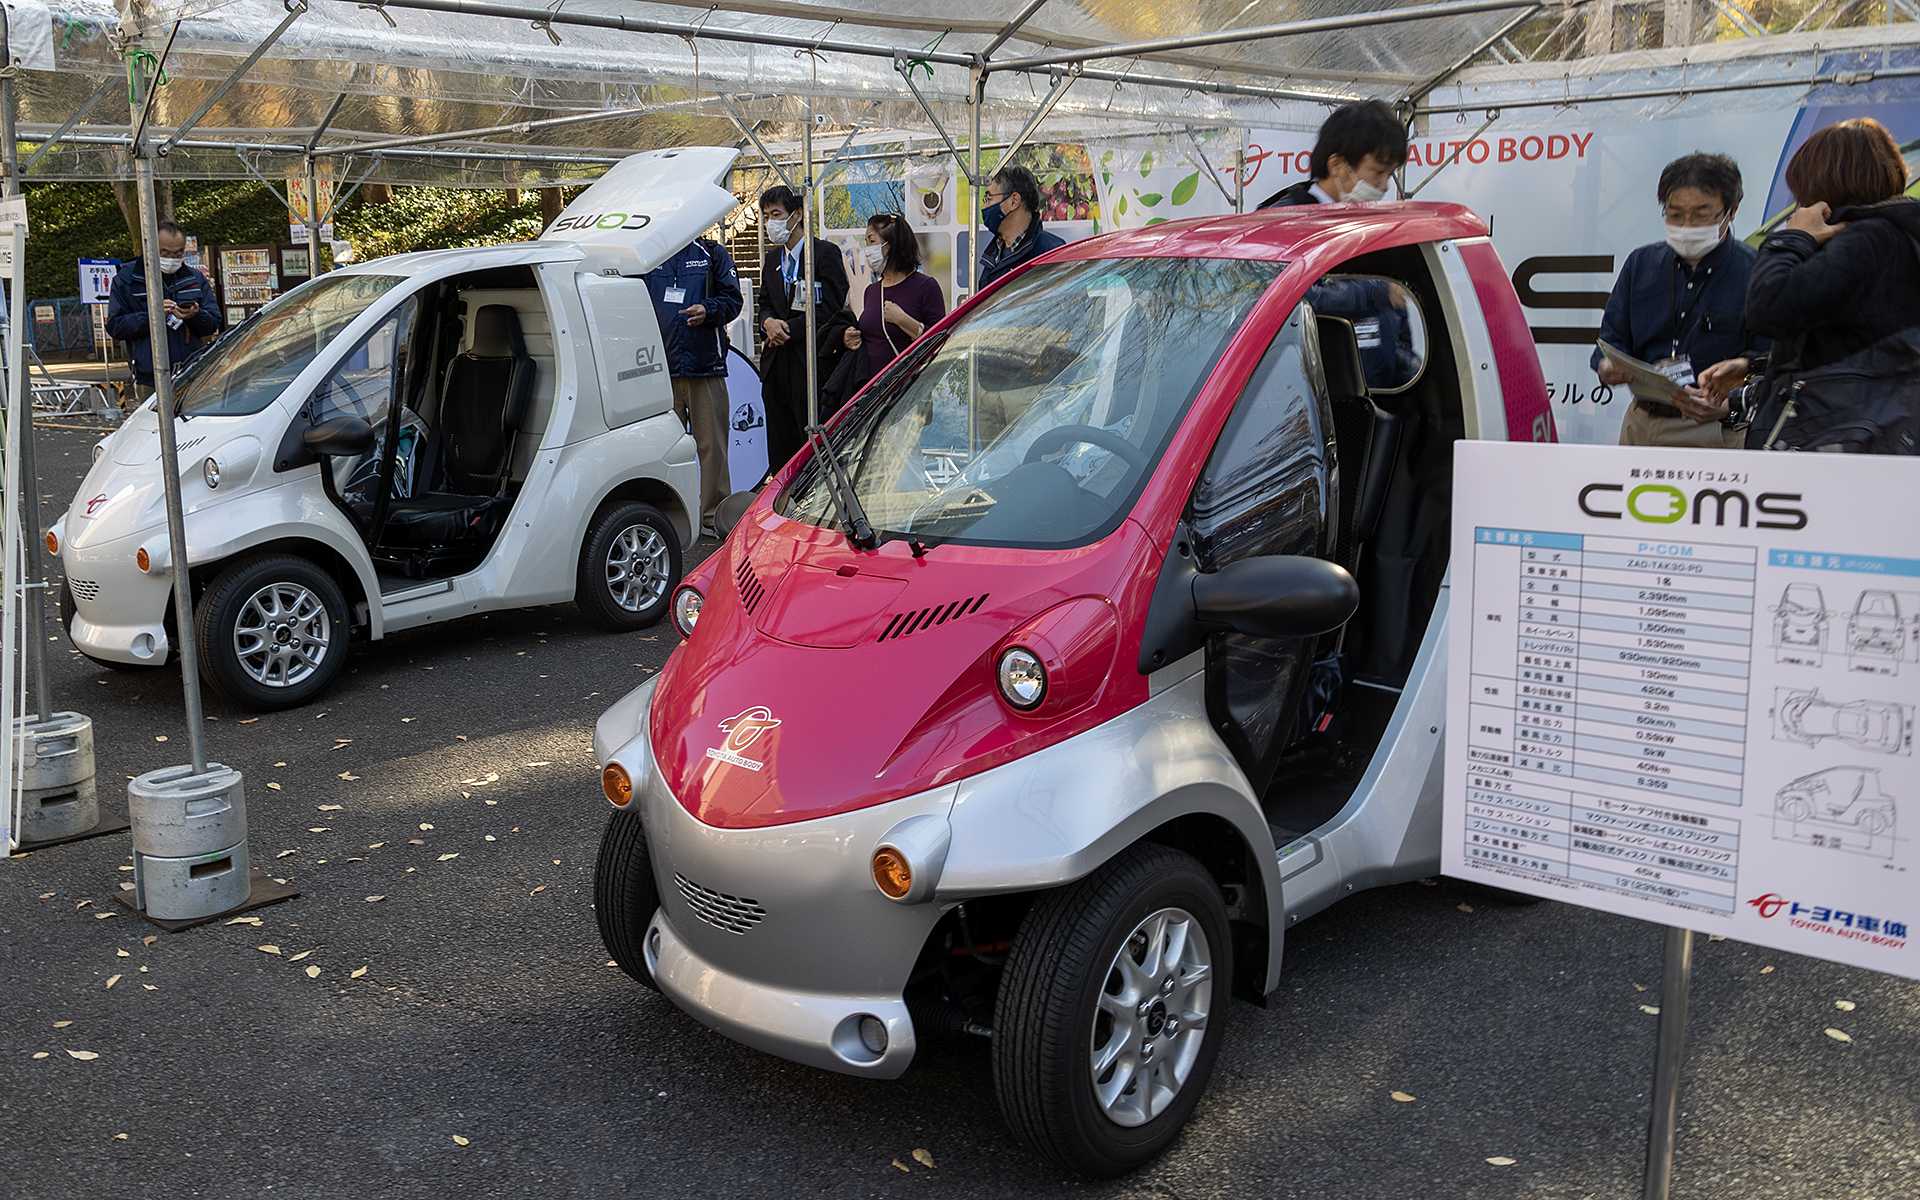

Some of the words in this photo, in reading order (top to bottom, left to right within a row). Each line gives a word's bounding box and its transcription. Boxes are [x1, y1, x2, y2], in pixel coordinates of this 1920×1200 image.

[1405, 139, 1490, 167] AUTO
[1498, 132, 1594, 162] BODY
[636, 344, 655, 366] EV
[707, 749, 727, 760] TOYOTA
[727, 755, 743, 765] AUTO
[743, 760, 761, 770] BODY
[1788, 918, 1834, 936] TOYOTA
[1836, 928, 1870, 943] AUTO
[1871, 935, 1907, 950] BODY
[1789, 902, 1908, 939] トヨタ車体
